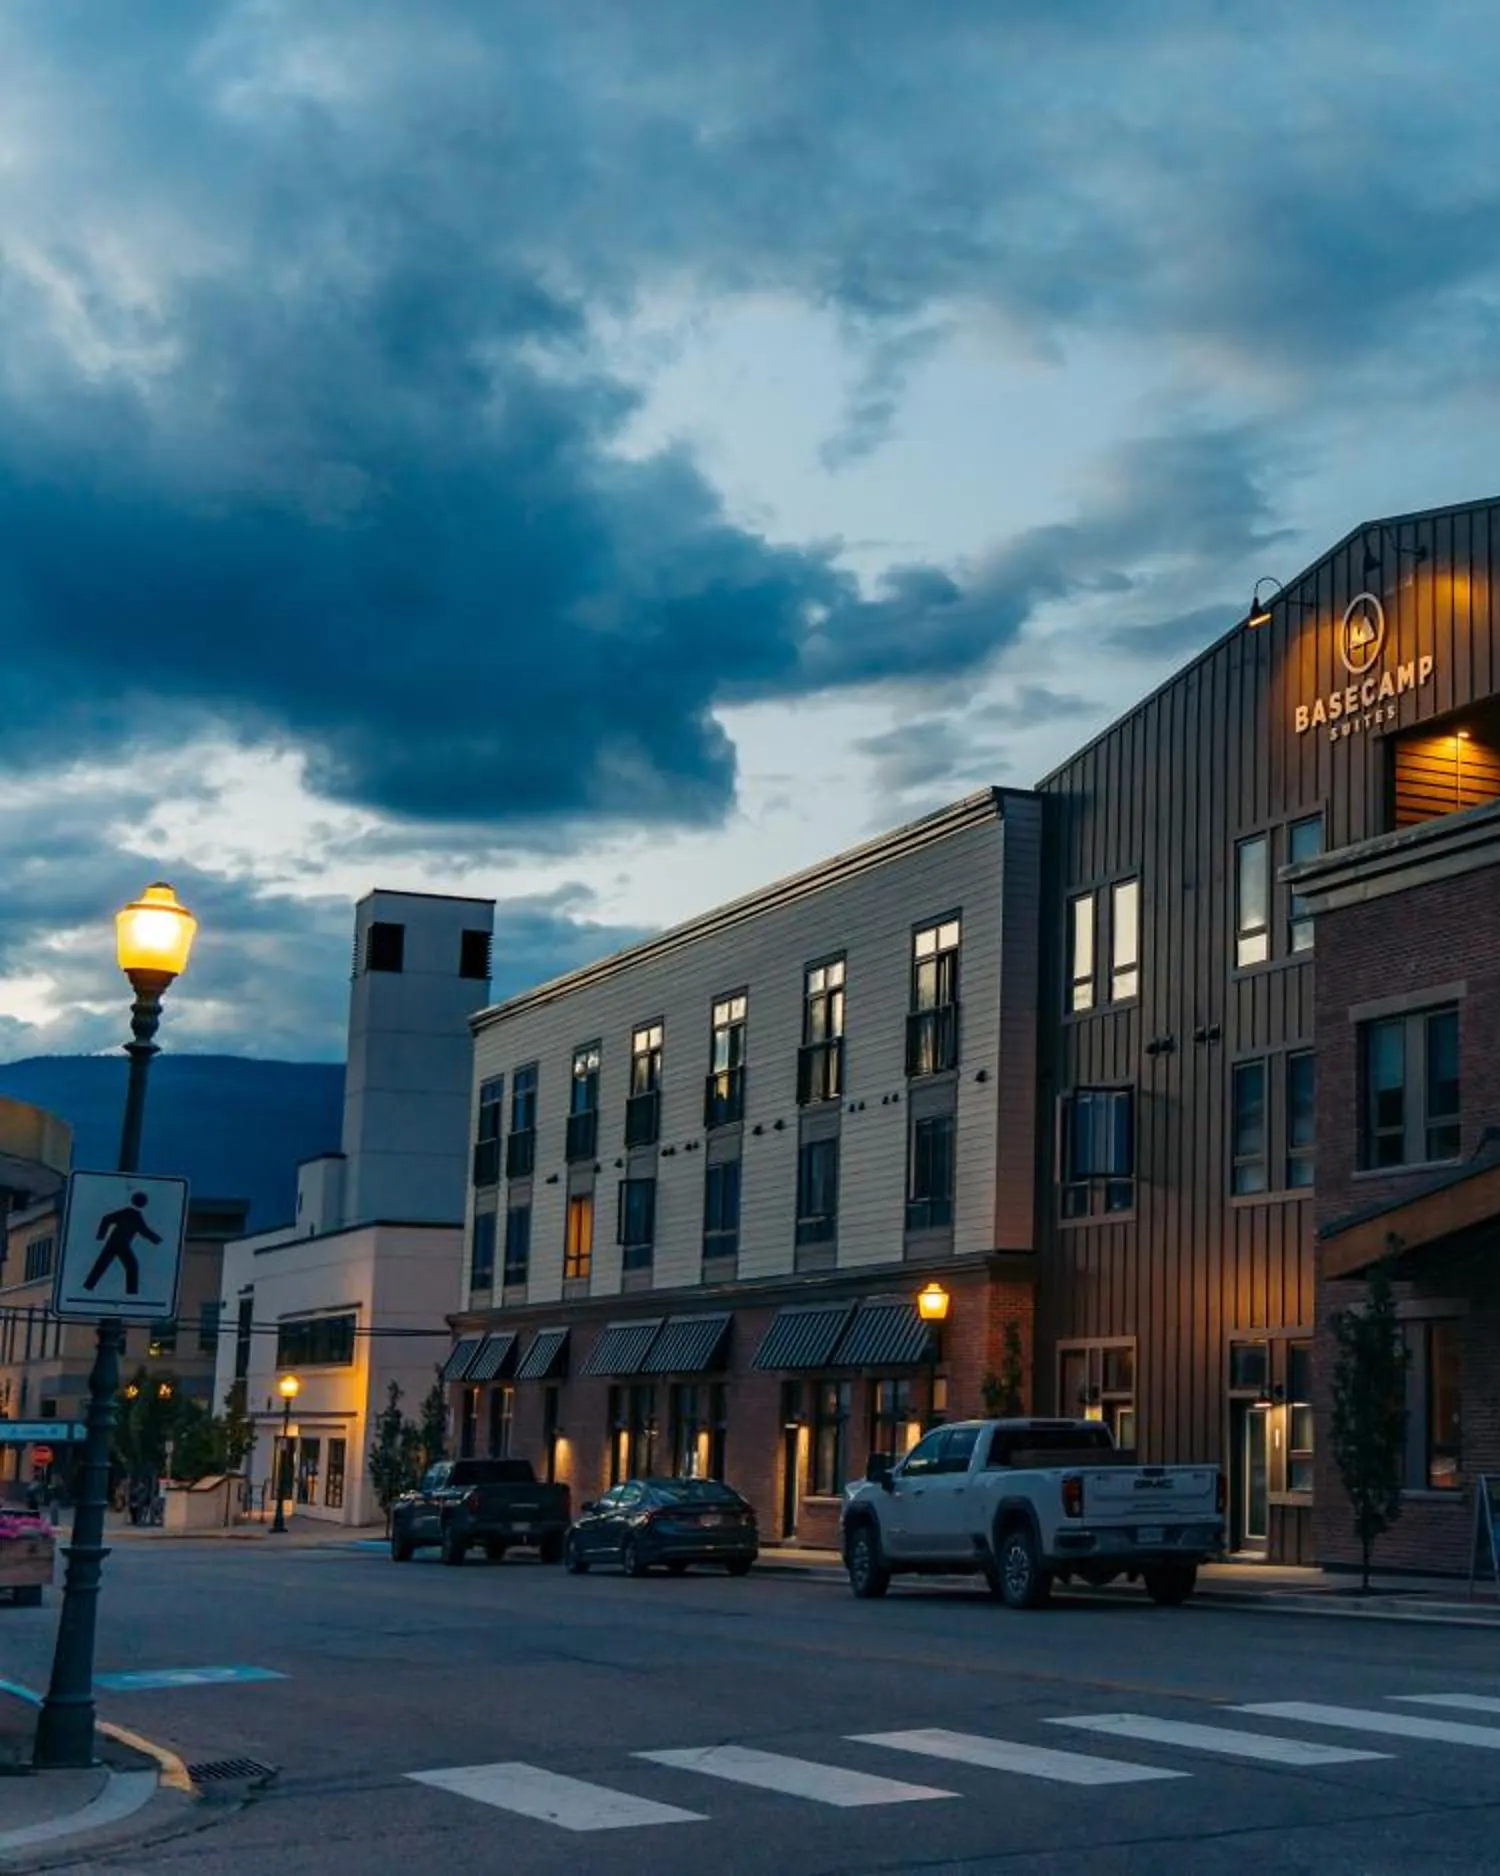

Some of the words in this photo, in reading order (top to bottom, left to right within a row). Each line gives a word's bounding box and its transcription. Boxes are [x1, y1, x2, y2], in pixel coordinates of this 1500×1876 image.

[1295, 655, 1433, 733] BASECAMP
[1329, 705, 1396, 742] SUITES
[1133, 1479, 1174, 1489] GMC
